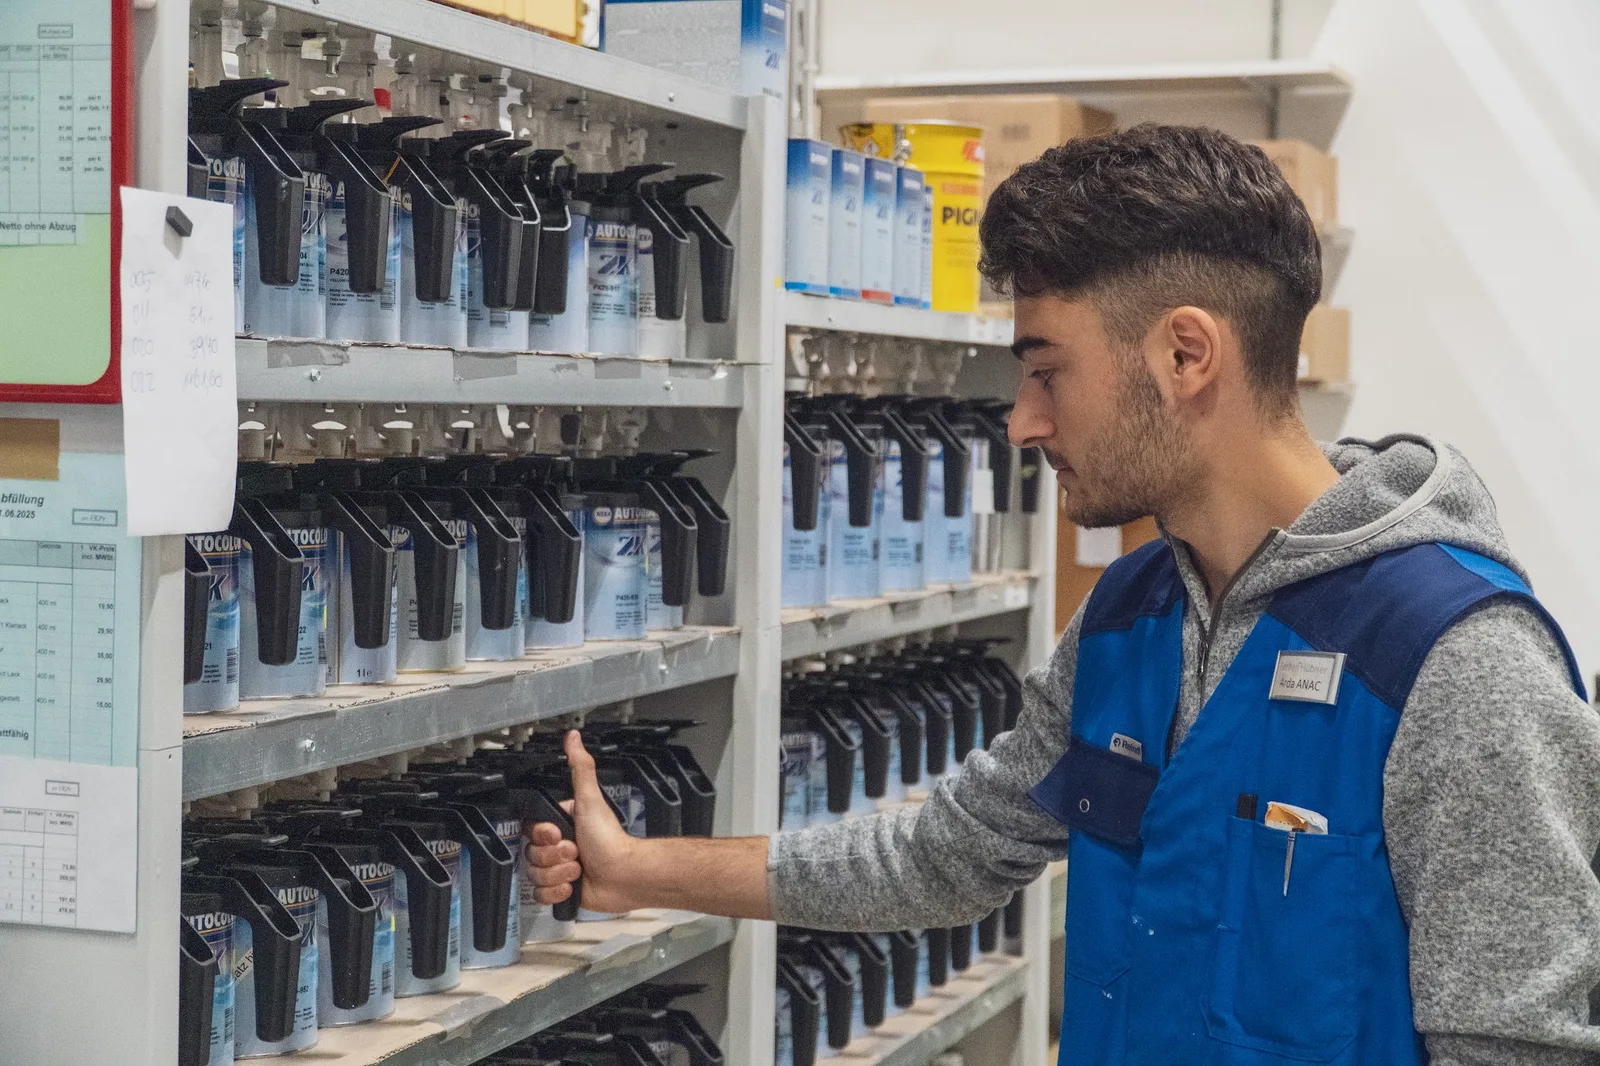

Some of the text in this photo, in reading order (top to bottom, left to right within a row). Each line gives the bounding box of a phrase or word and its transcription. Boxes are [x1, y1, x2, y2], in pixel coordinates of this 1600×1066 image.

[25, 222, 46, 231] ohne
[49, 221, 76, 233] Abzug
[0, 493, 45, 508] bfüllung
[1280, 677, 1321, 691] Arda ANAC
